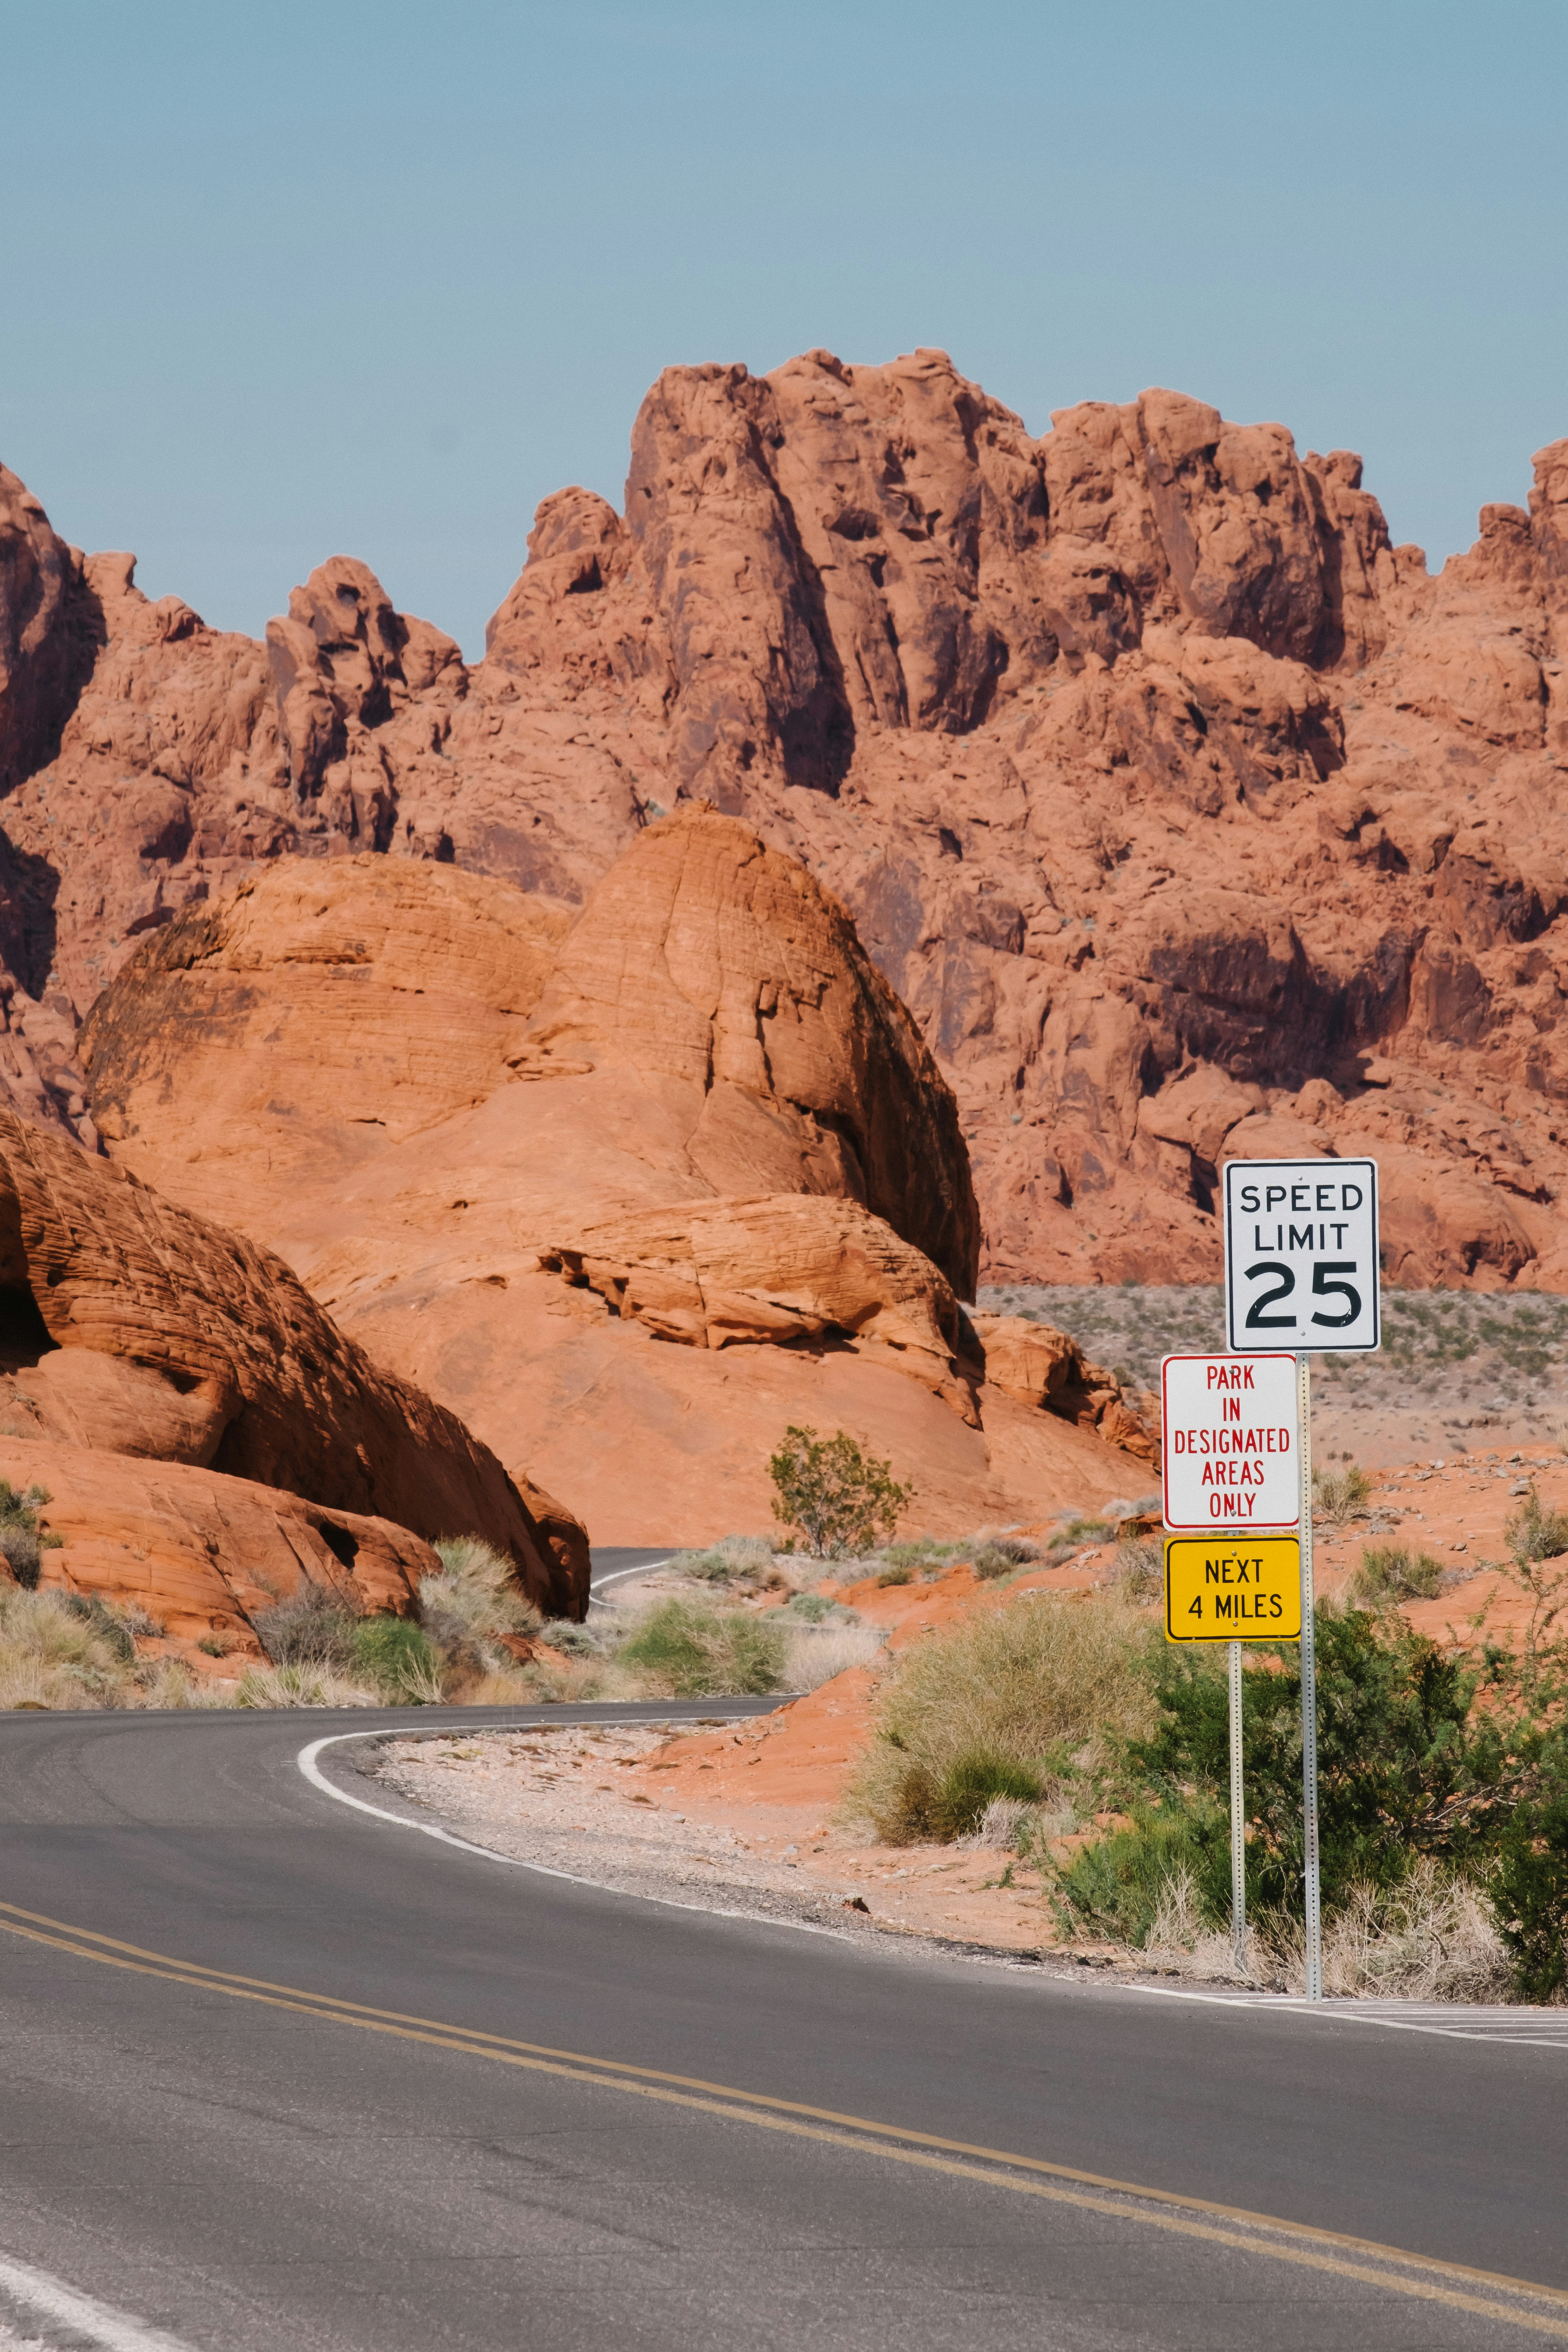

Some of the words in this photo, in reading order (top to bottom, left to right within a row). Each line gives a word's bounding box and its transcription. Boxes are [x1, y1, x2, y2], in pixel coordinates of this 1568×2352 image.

[1240, 1184, 1363, 1212] SPEED
[1255, 1223, 1348, 1250] LIMIT
[1244, 1261, 1362, 1328] 25
[1207, 1365, 1255, 1389] PARK
[1223, 1397, 1240, 1421] IN
[1175, 1428, 1289, 1454] DESIGNATED
[1201, 1460, 1264, 1485] AREAS
[1210, 1493, 1256, 1517] ONLY
[1205, 1559, 1263, 1583] NEXT
[1188, 1595, 1202, 1619] 4
[1216, 1593, 1282, 1618] MILES
